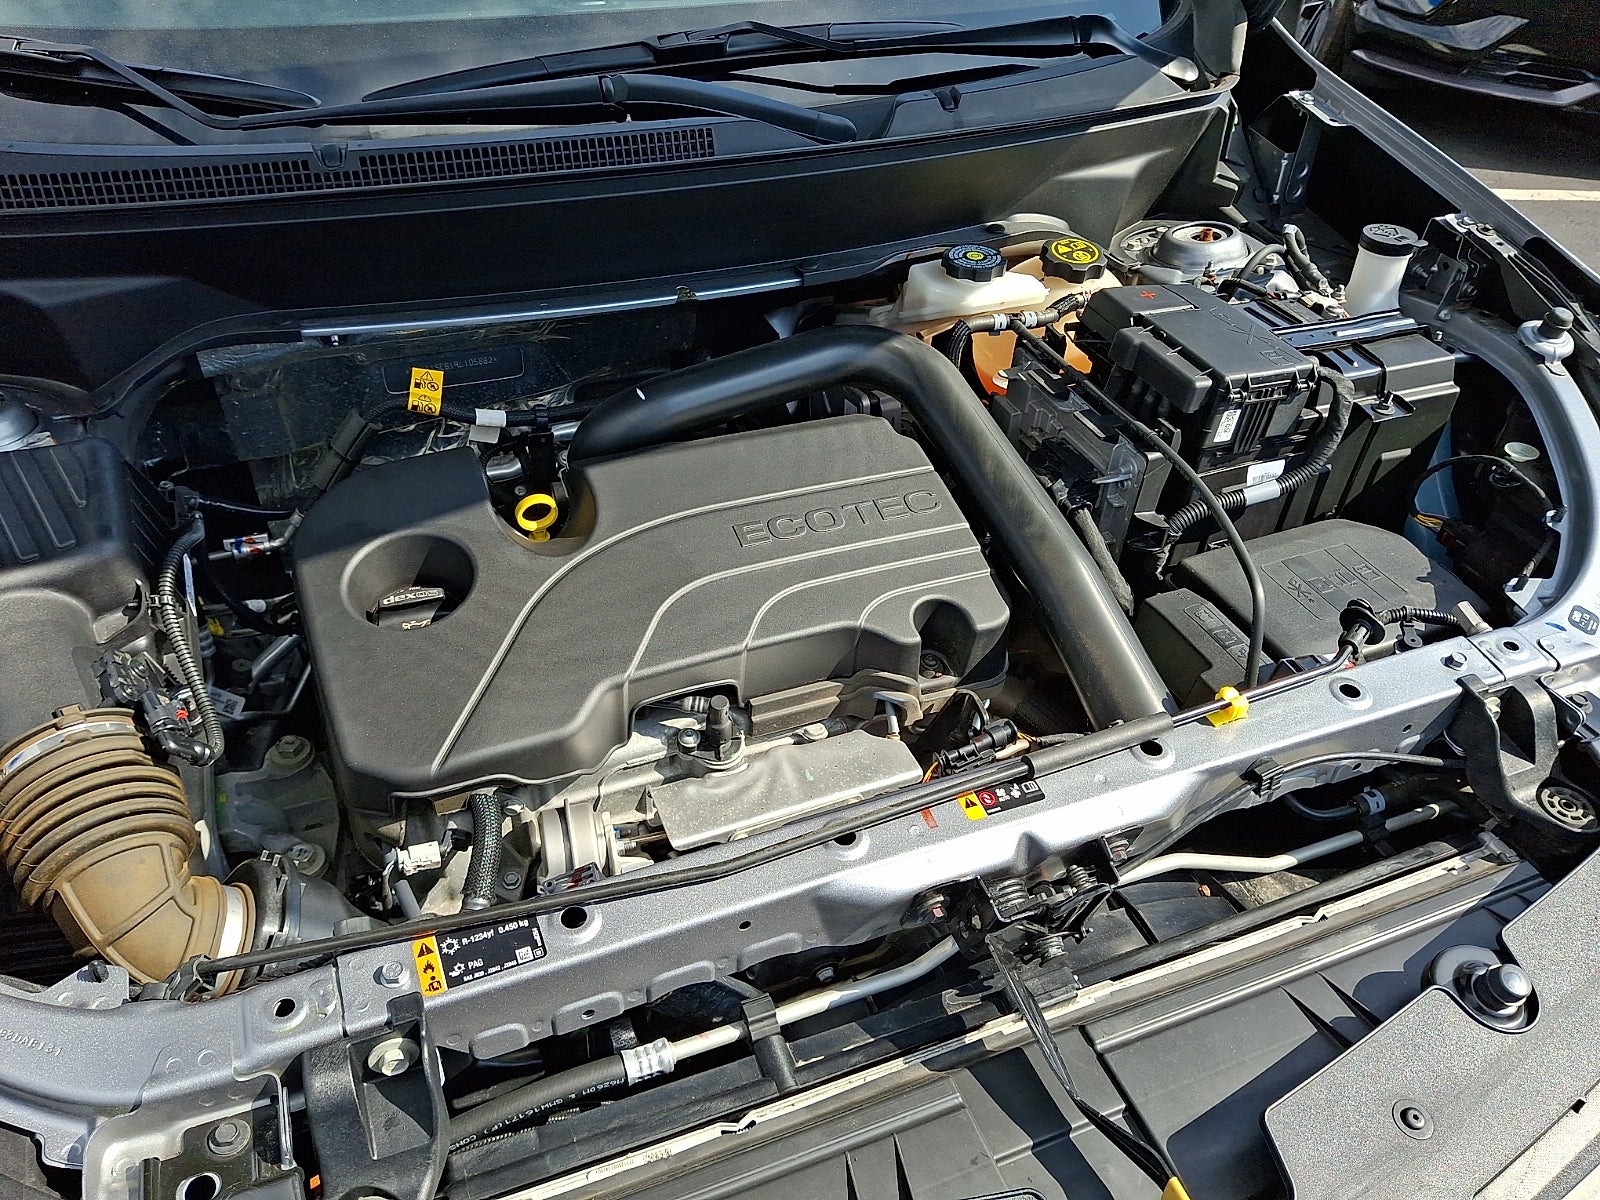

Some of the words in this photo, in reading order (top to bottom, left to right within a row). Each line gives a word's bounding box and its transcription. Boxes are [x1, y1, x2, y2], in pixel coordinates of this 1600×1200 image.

[731, 489, 942, 548] ECOTEC
[382, 589, 439, 605] dexos
[461, 930, 495, 945] R-1234yf
[499, 923, 518, 934] 0.450
[519, 920, 529, 930] kg
[467, 958, 484, 970] PAG
